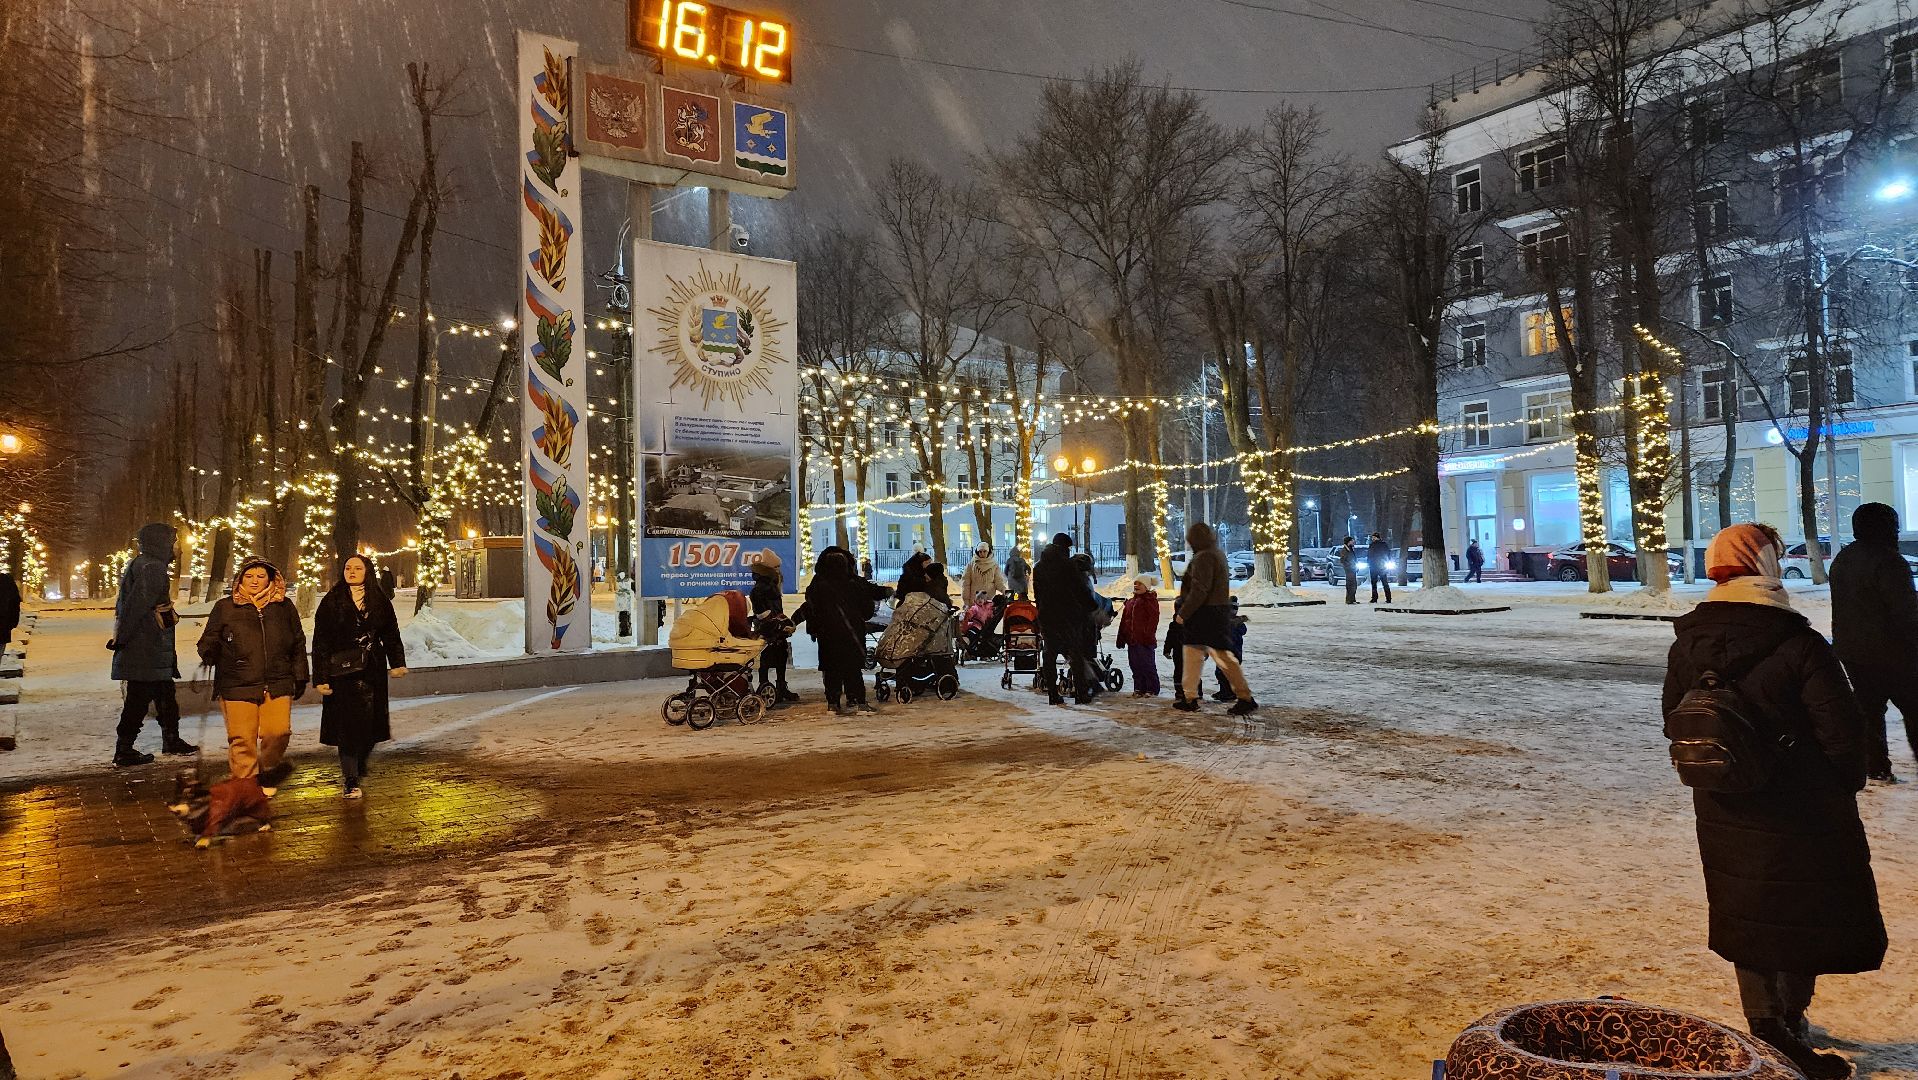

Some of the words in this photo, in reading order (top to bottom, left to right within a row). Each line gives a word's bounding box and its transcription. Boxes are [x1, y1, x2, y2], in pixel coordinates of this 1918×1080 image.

[701, 364, 741, 378] СТУПИНО
[669, 542, 739, 567] 1507
[742, 551, 763, 566] го
[690, 571, 737, 579] упоминание
